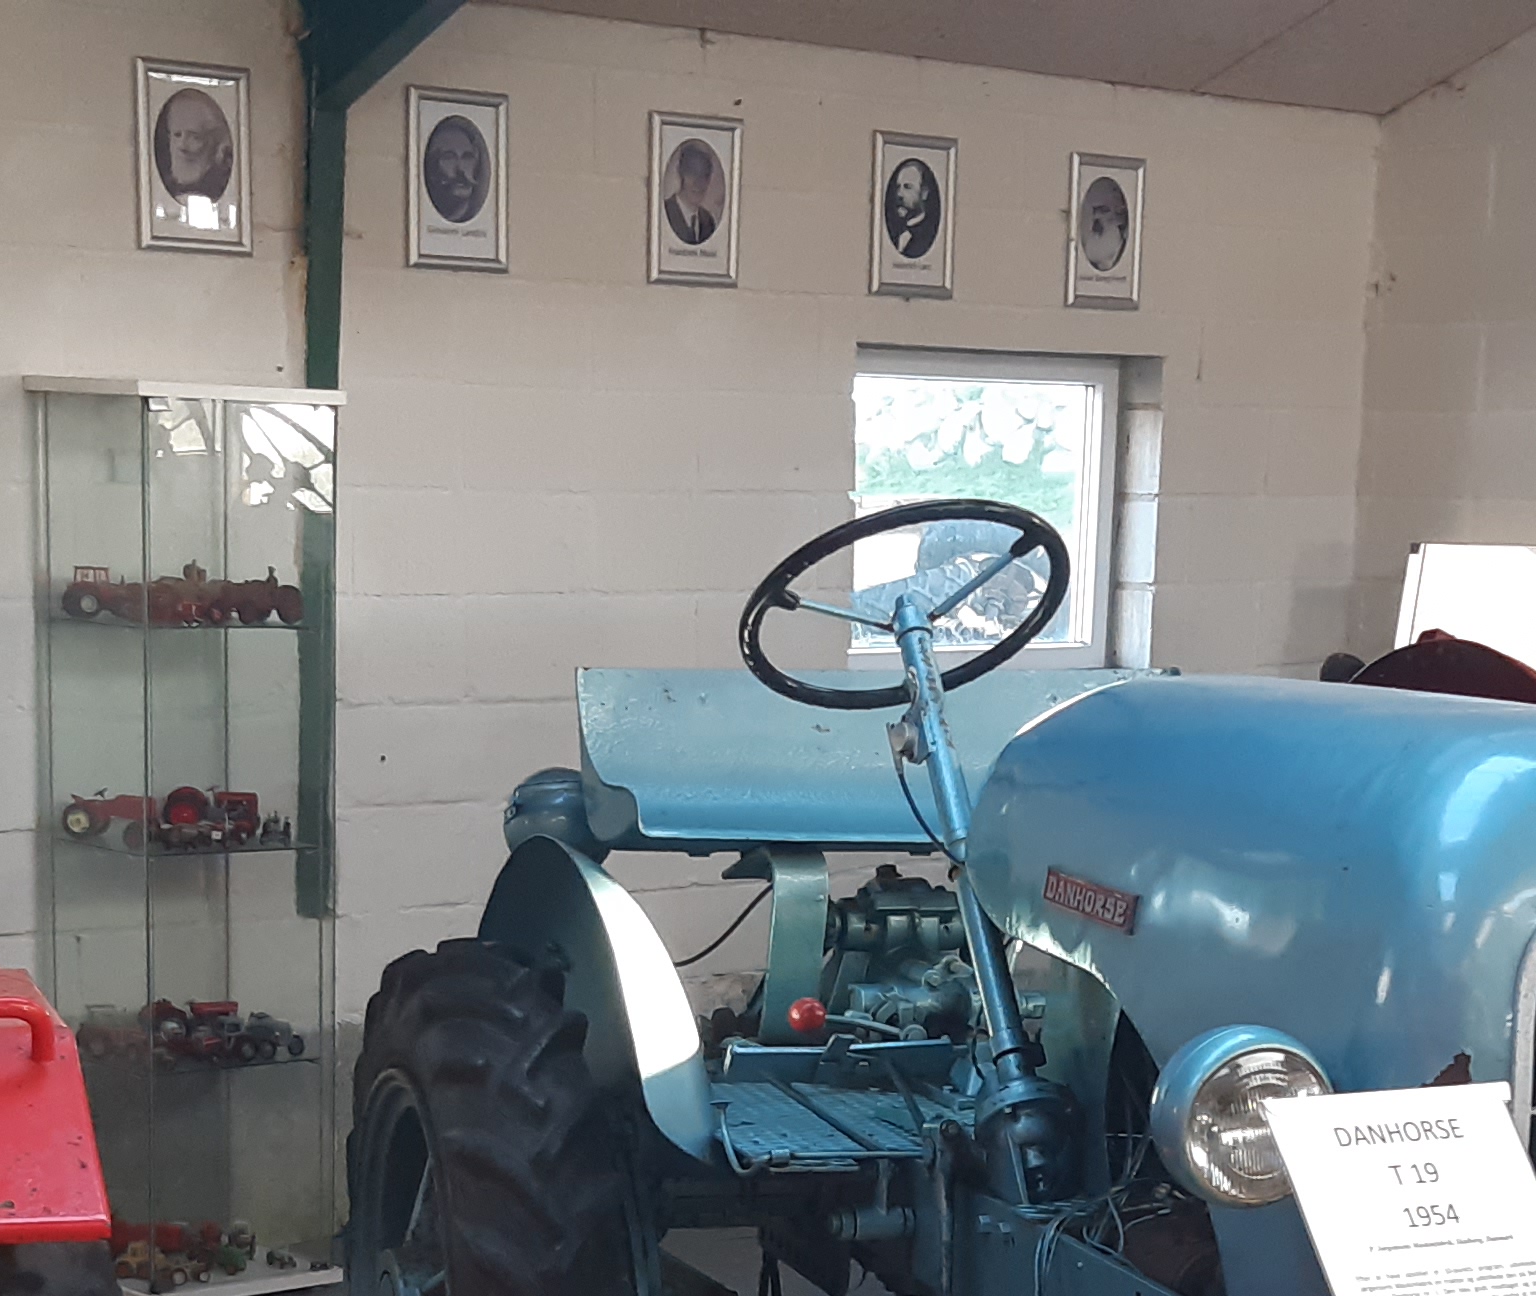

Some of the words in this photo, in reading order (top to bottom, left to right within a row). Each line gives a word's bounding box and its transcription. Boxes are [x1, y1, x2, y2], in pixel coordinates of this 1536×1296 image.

[1045, 875, 1127, 925] DANHORSE
[1333, 1118, 1465, 1147] DANHORSE
[1387, 1164, 1403, 1185] T
[1410, 1162, 1440, 1184] 19
[1402, 1203, 1460, 1228] 1954
